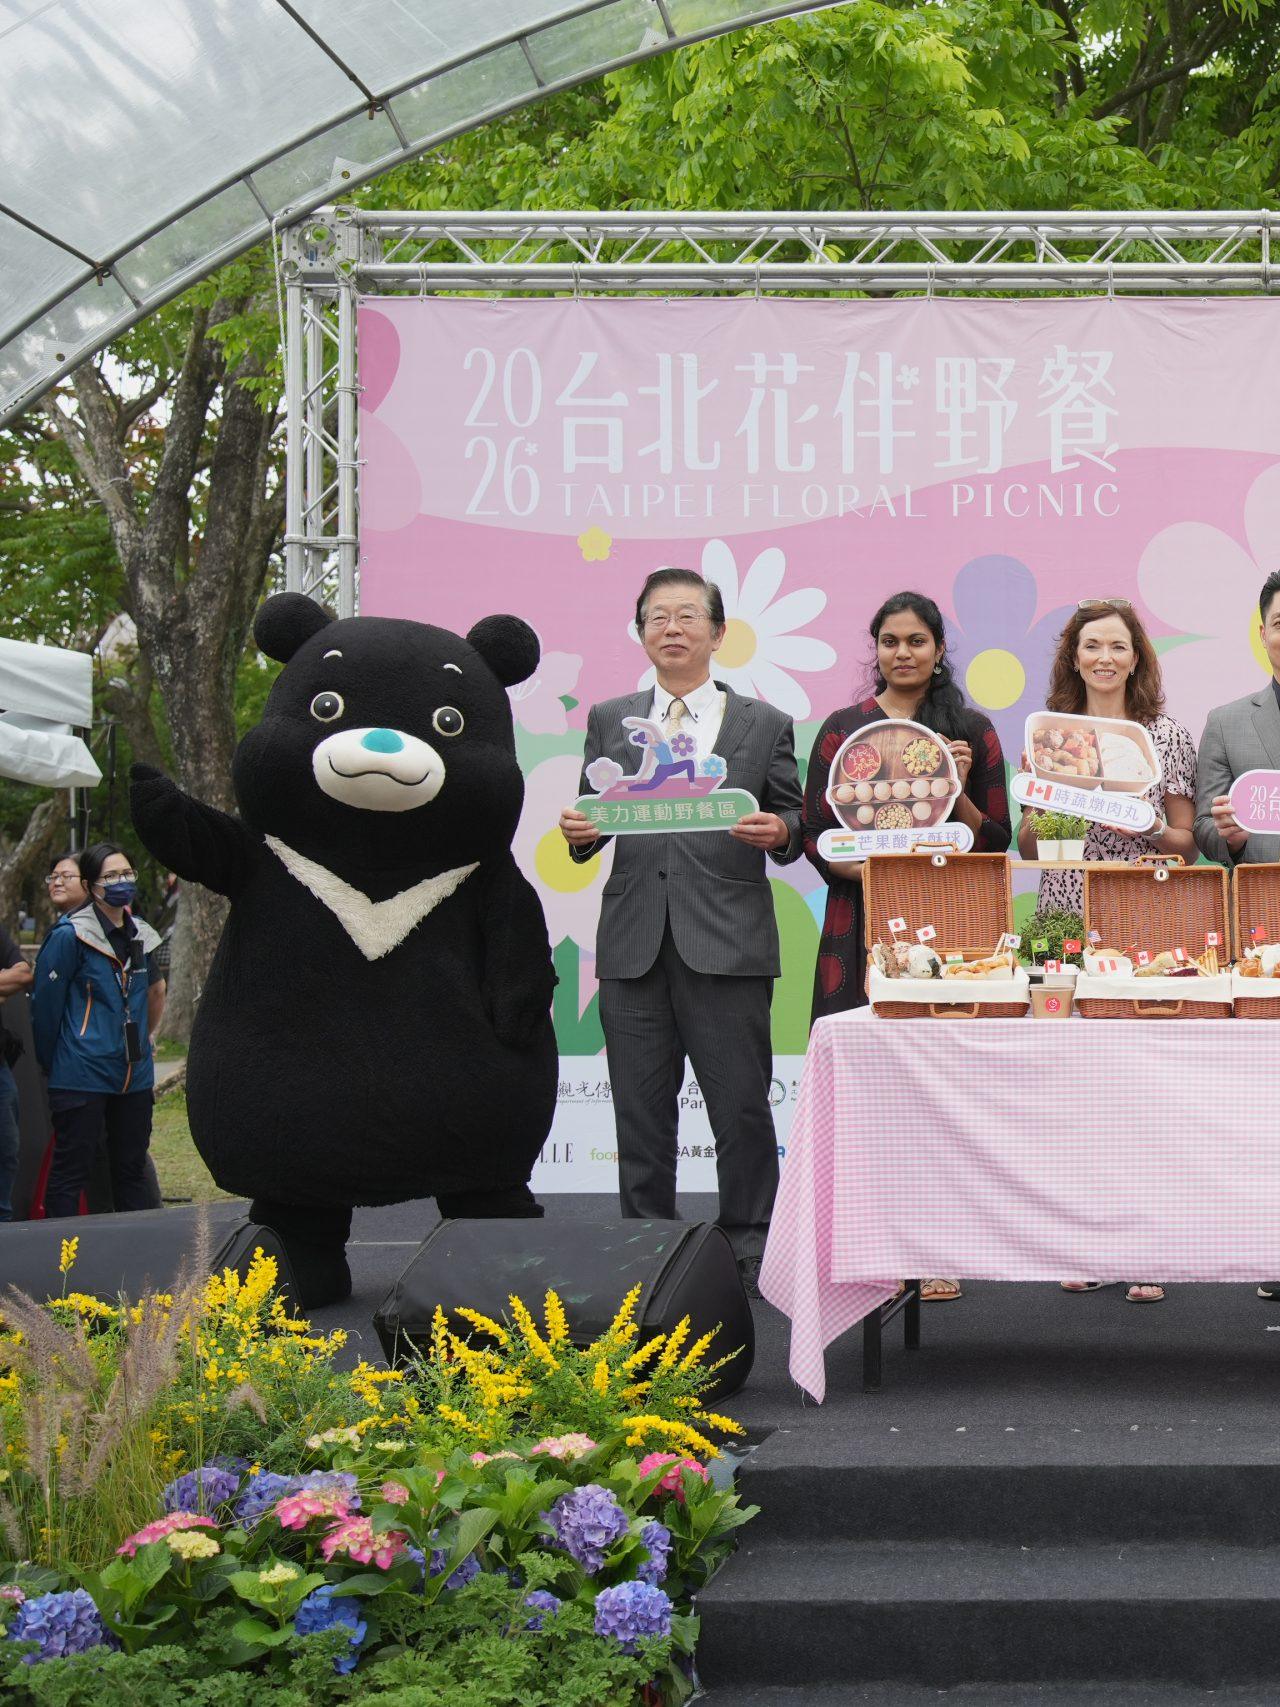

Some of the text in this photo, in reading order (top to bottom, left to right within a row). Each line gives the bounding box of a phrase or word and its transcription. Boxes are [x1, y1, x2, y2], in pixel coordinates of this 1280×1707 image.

[463, 348, 543, 427] 20
[555, 345, 1120, 475] 台北花伴野餐
[464, 436, 541, 517] 26
[556, 482, 1121, 519] TAIPEI FLORAL PICNIC
[1054, 786, 1140, 822] 時蔬燉肉丸
[1250, 785, 1267, 802] 20
[589, 801, 738, 824] 美力運動野餐區
[1250, 803, 1266, 821] 26
